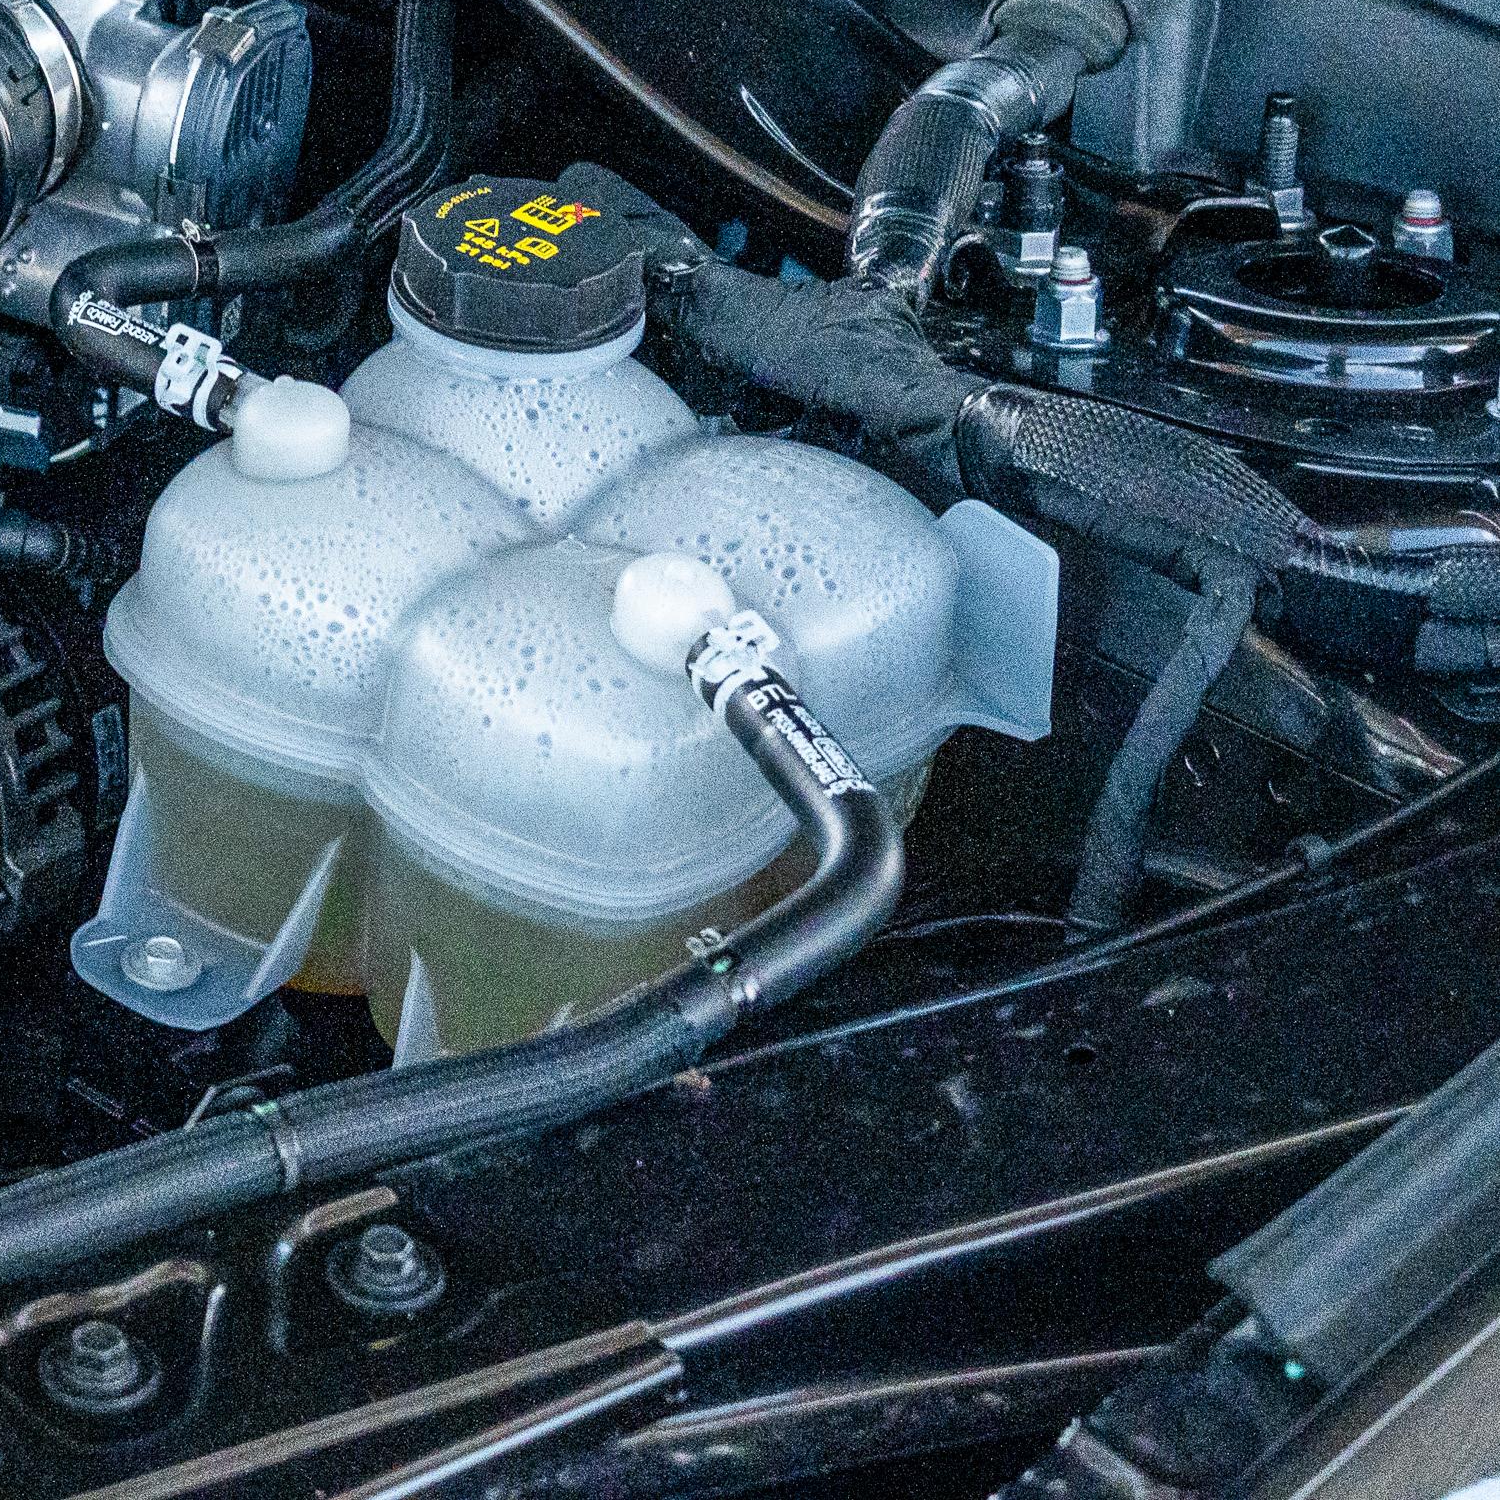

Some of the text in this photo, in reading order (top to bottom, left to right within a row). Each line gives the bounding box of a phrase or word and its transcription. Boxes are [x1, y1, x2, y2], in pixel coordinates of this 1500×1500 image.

[463, 231, 497, 250] 145
[455, 242, 511, 270] 21 psi
[85, 306, 121, 331] FoMoCo
